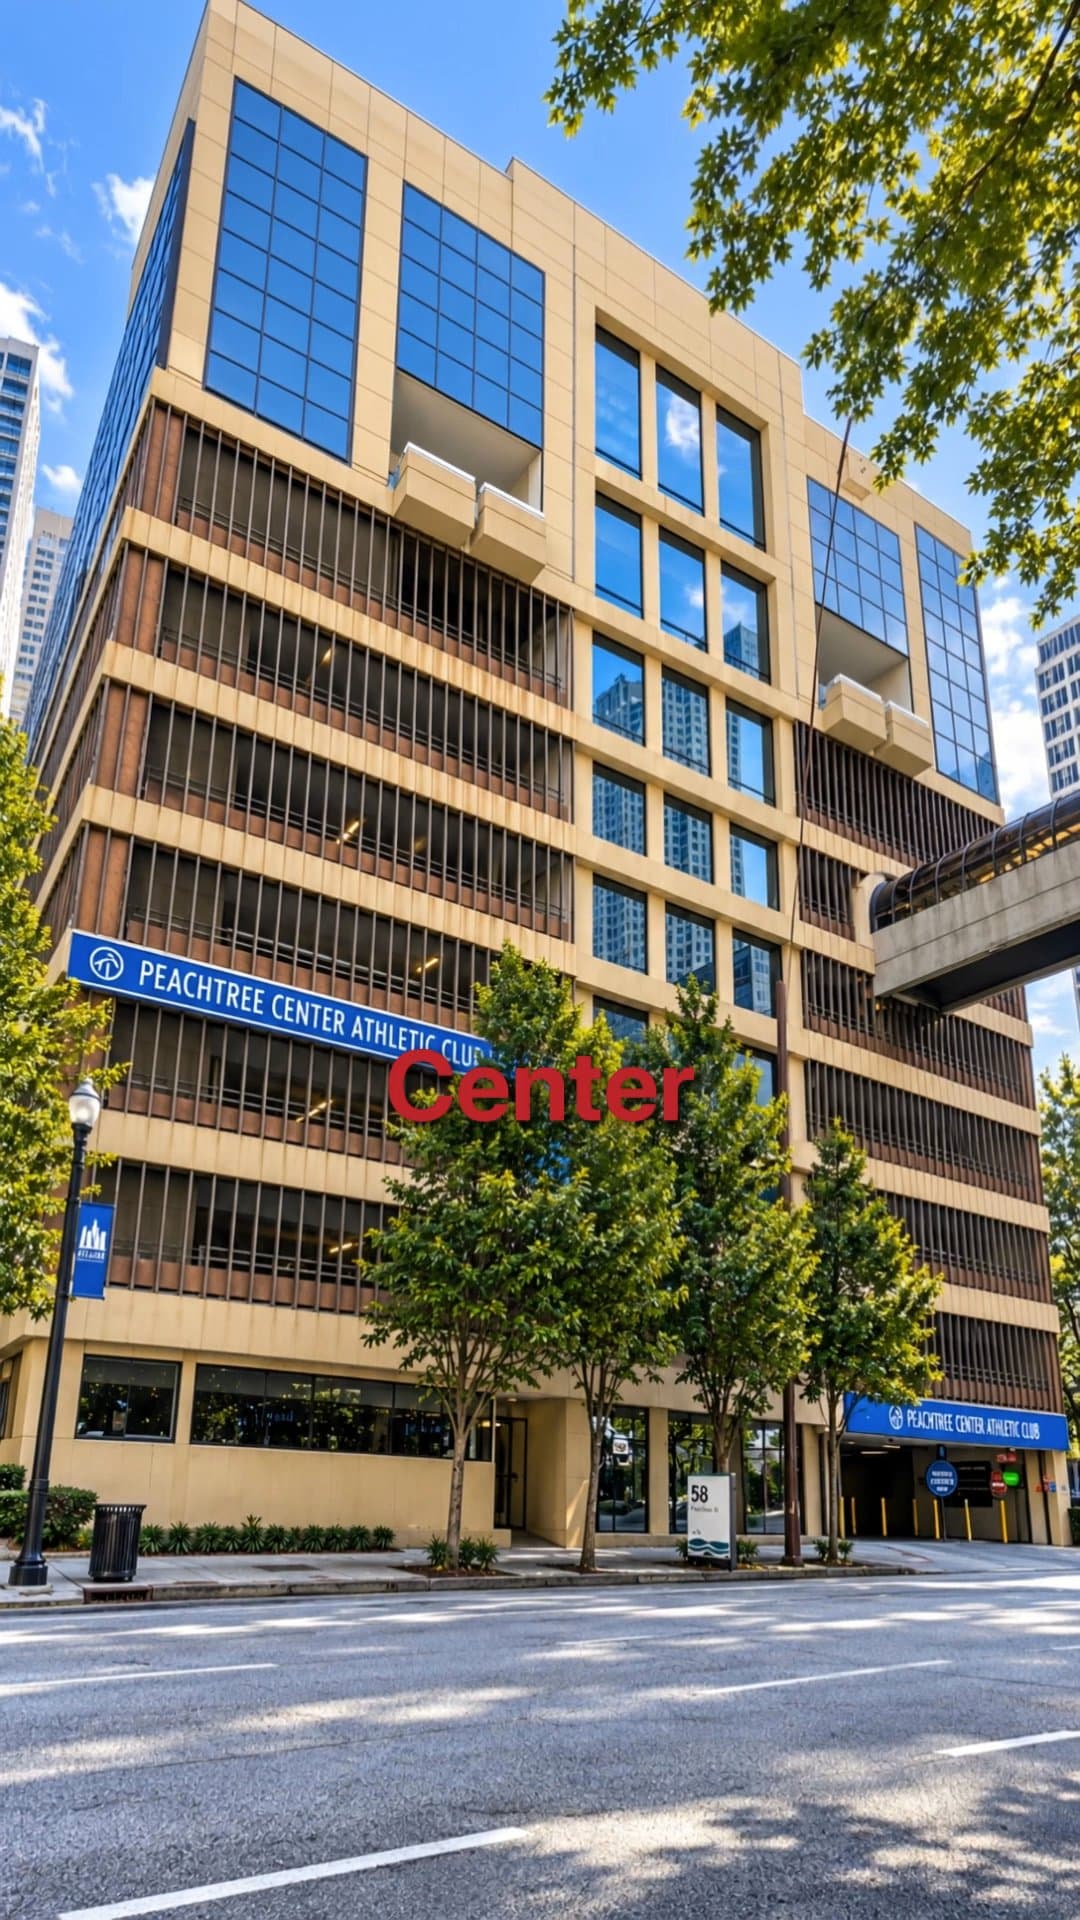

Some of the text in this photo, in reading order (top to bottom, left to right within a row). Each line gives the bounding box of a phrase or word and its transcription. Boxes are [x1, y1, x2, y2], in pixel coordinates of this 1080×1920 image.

[139, 960, 265, 1015] PEACHTREE
[271, 994, 345, 1036] CENTER
[351, 1015, 435, 1051] ATHLETIC
[907, 1409, 1040, 1440] PEACHTREE CENTER ATHLETIC CLUB
[691, 1484, 709, 1503] 58
